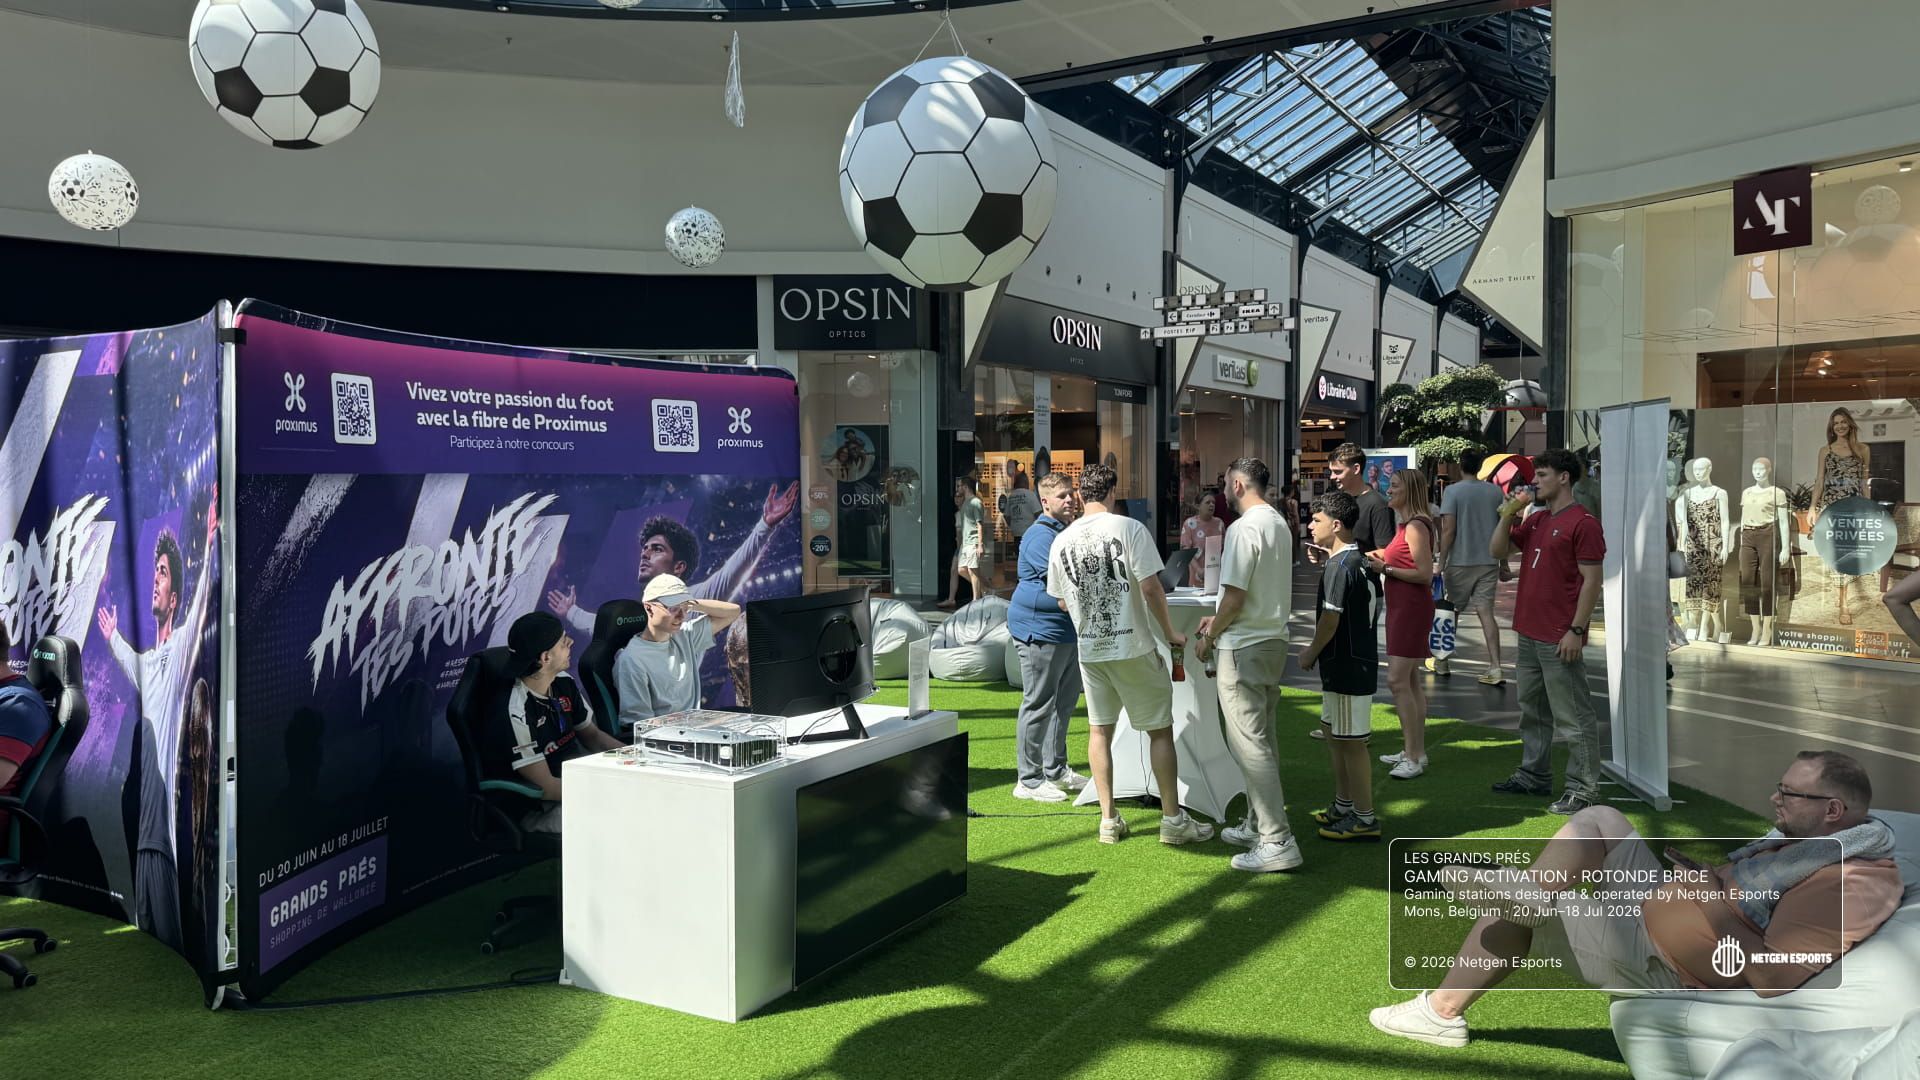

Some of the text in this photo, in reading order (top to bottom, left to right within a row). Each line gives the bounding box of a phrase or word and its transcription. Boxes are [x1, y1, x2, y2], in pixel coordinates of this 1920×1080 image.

[780, 287, 912, 321] OPSIN
[1304, 314, 1329, 324] veritas
[828, 330, 866, 338] OPTICS
[1052, 315, 1102, 351] OPSIN
[1219, 360, 1246, 381] veritas
[406, 382, 614, 411] Vivez votre passion du foot
[1327, 382, 1357, 401] Librairie Club
[276, 418, 318, 434] proximus
[417, 409, 608, 432] avec la fibre de Proximus
[450, 435, 575, 451] Participez à notre concours
[718, 438, 764, 449] proximus
[841, 493, 885, 506] OPSIN
[1828, 518, 1882, 529] VENTES
[1826, 529, 1885, 541] PRIVÉES
[1532, 548, 1541, 568] 7
[304, 490, 560, 696] AFFRONTE
[1779, 630, 1803, 638] votre
[1807, 632, 1842, 642] shoppi
[350, 630, 415, 719] TES
[259, 816, 388, 888] DU 20 JUIN AU 18 JUILLET
[270, 879, 328, 927] GRANDS
[339, 856, 377, 890] PRÉS
[270, 914, 312, 949] SHOPPING
[317, 906, 327, 920] DE
[333, 881, 376, 911] WALLONIE
